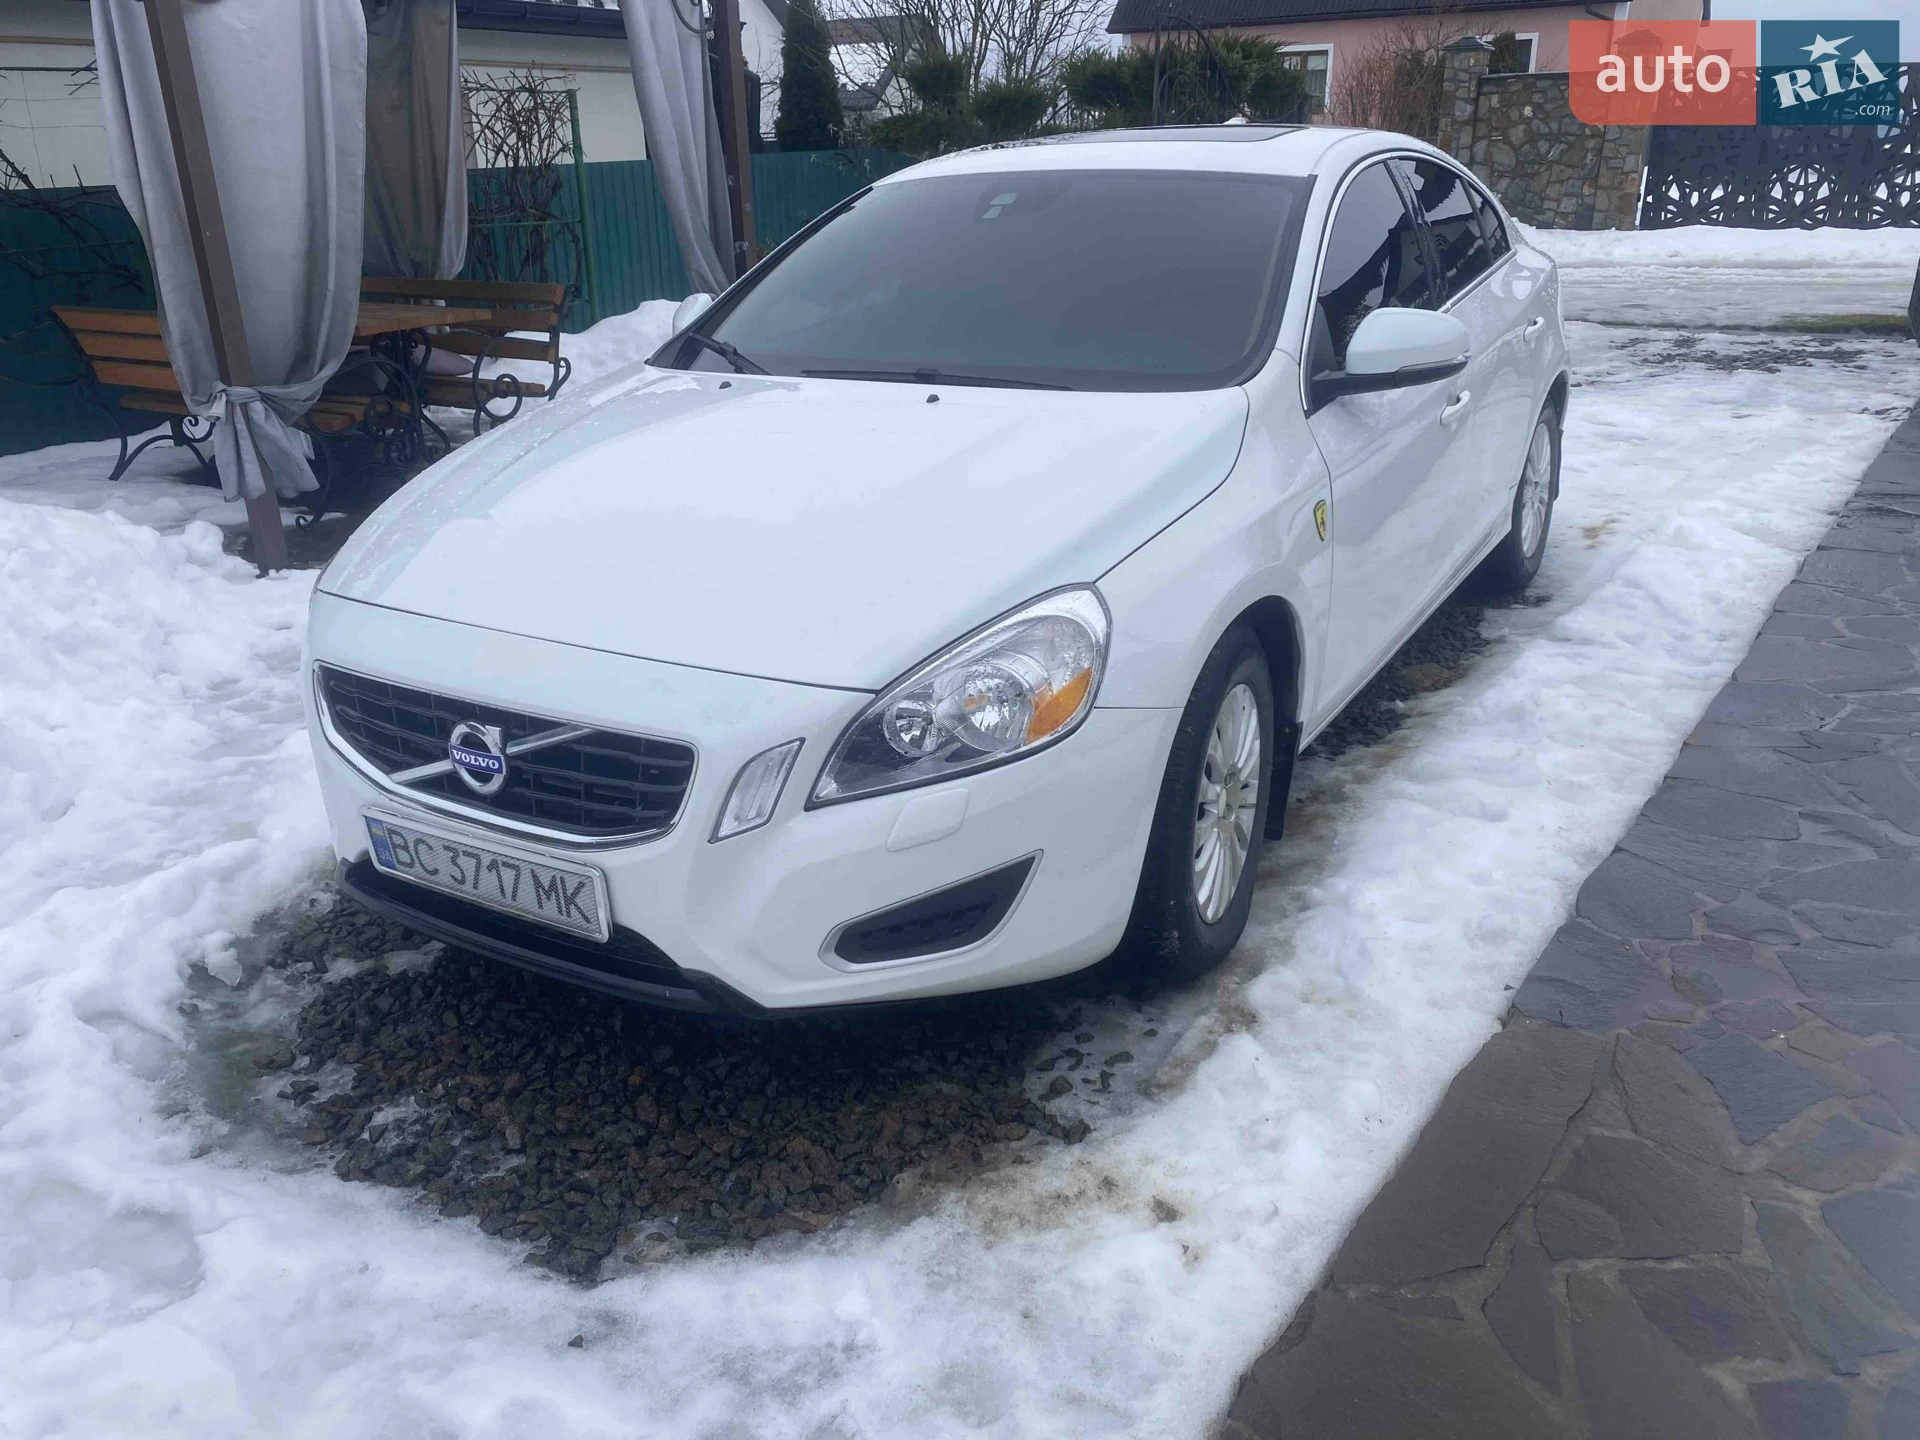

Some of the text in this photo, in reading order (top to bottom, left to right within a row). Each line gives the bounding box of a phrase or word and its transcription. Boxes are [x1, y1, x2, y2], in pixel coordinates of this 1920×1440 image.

[452, 750, 499, 769] VOLVO
[387, 828, 592, 924] BC 3717 MK
